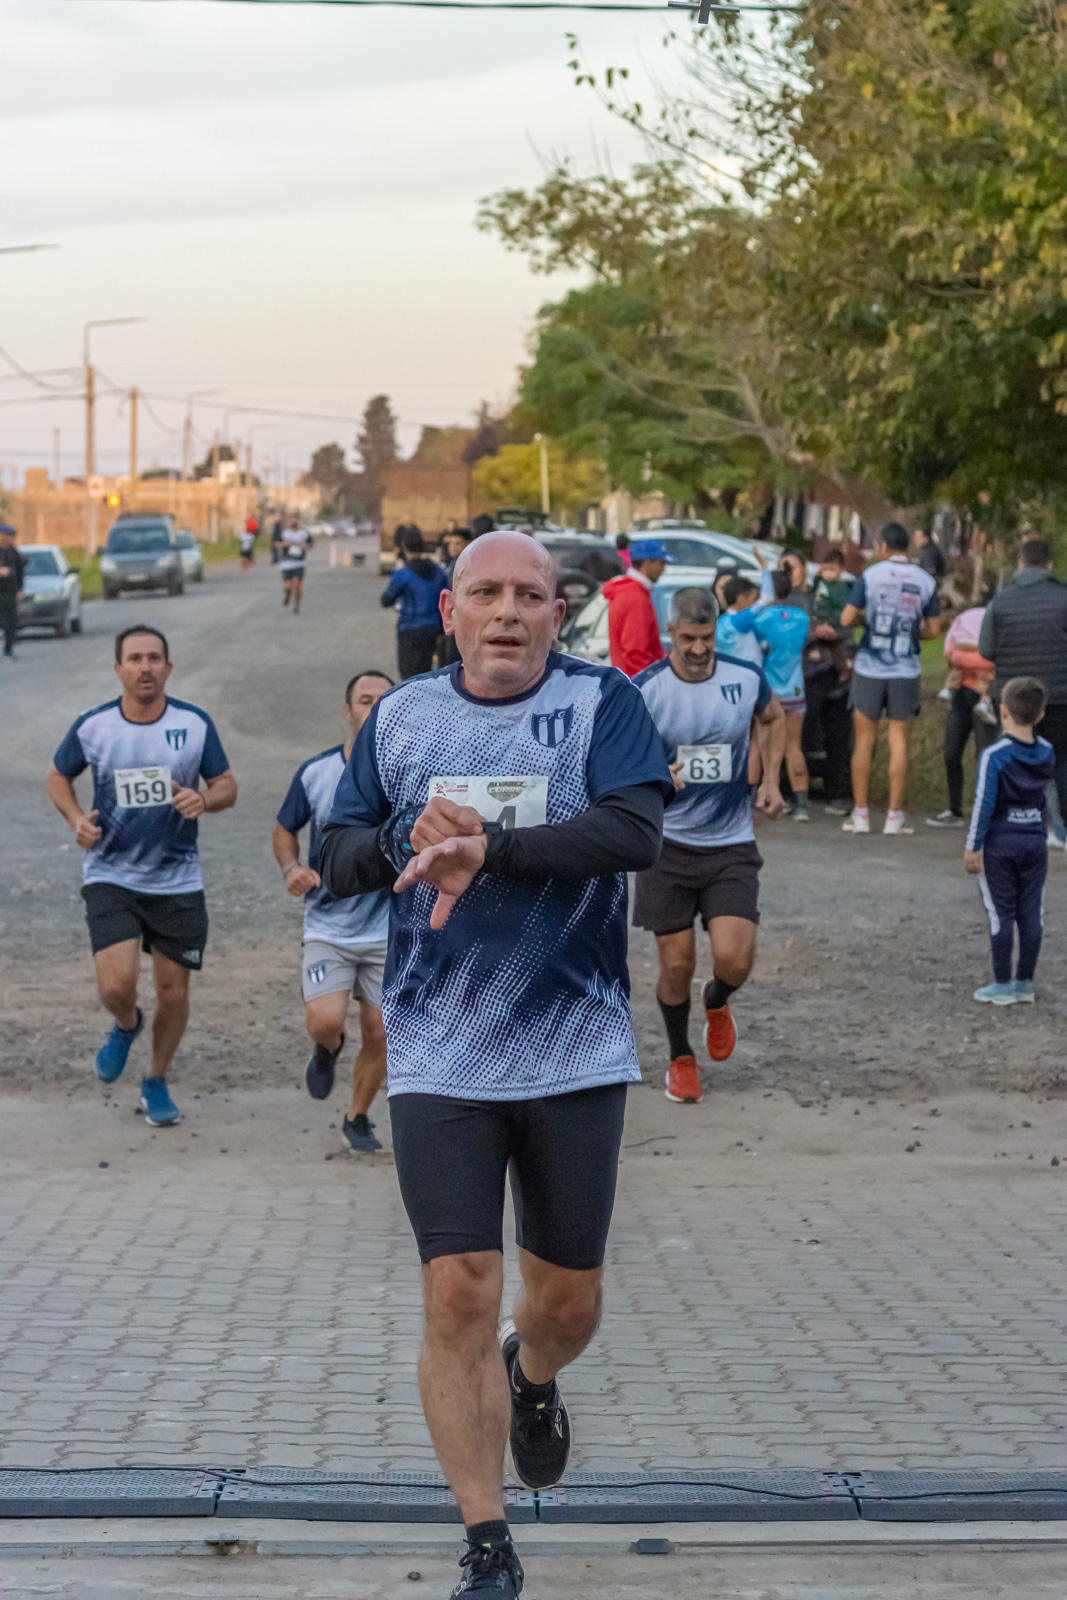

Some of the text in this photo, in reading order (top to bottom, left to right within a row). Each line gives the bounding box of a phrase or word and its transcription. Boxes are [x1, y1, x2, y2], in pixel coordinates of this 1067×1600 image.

[690, 758, 721, 780] 63
[120, 780, 166, 805] 159
[488, 786, 523, 794] CORRE
